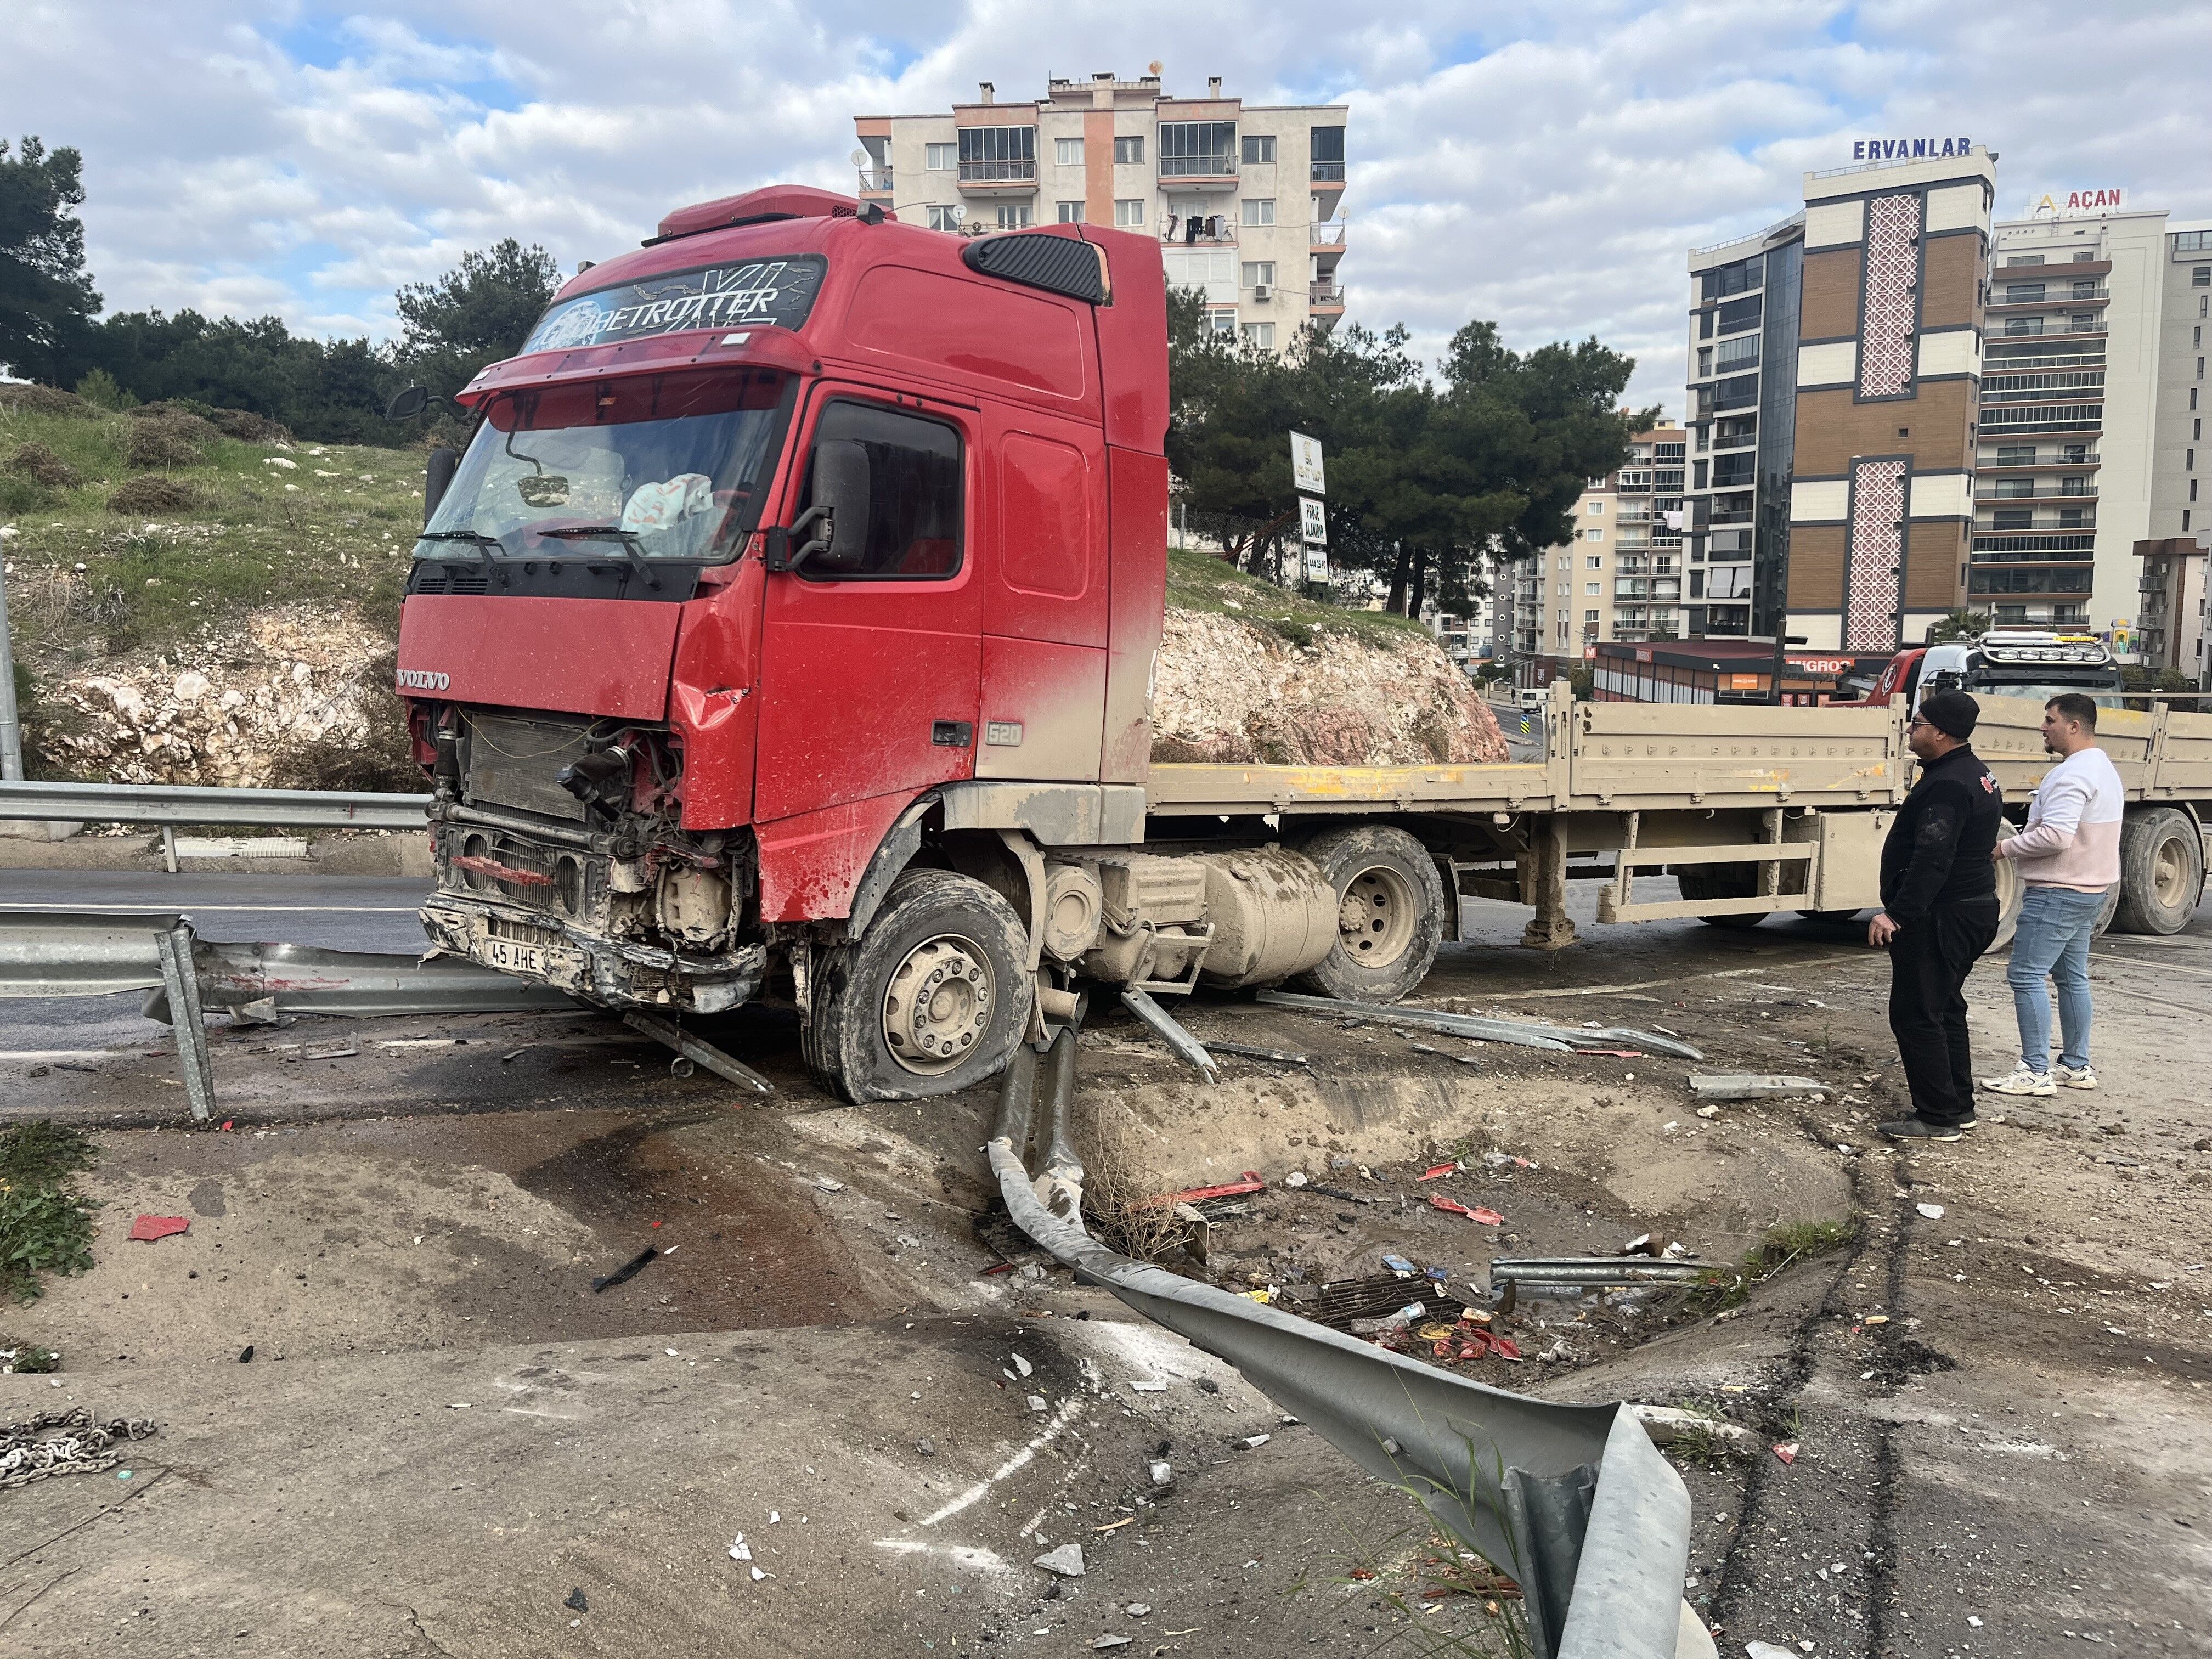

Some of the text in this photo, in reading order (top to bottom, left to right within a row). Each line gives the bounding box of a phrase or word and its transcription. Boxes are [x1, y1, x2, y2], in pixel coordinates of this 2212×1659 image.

[1853, 137, 1971, 160] ERVANLAR
[2068, 189, 2120, 210] AÇAN
[396, 669, 450, 691] VOLVO
[493, 943, 506, 964] 45
[514, 947, 537, 969] AHE
